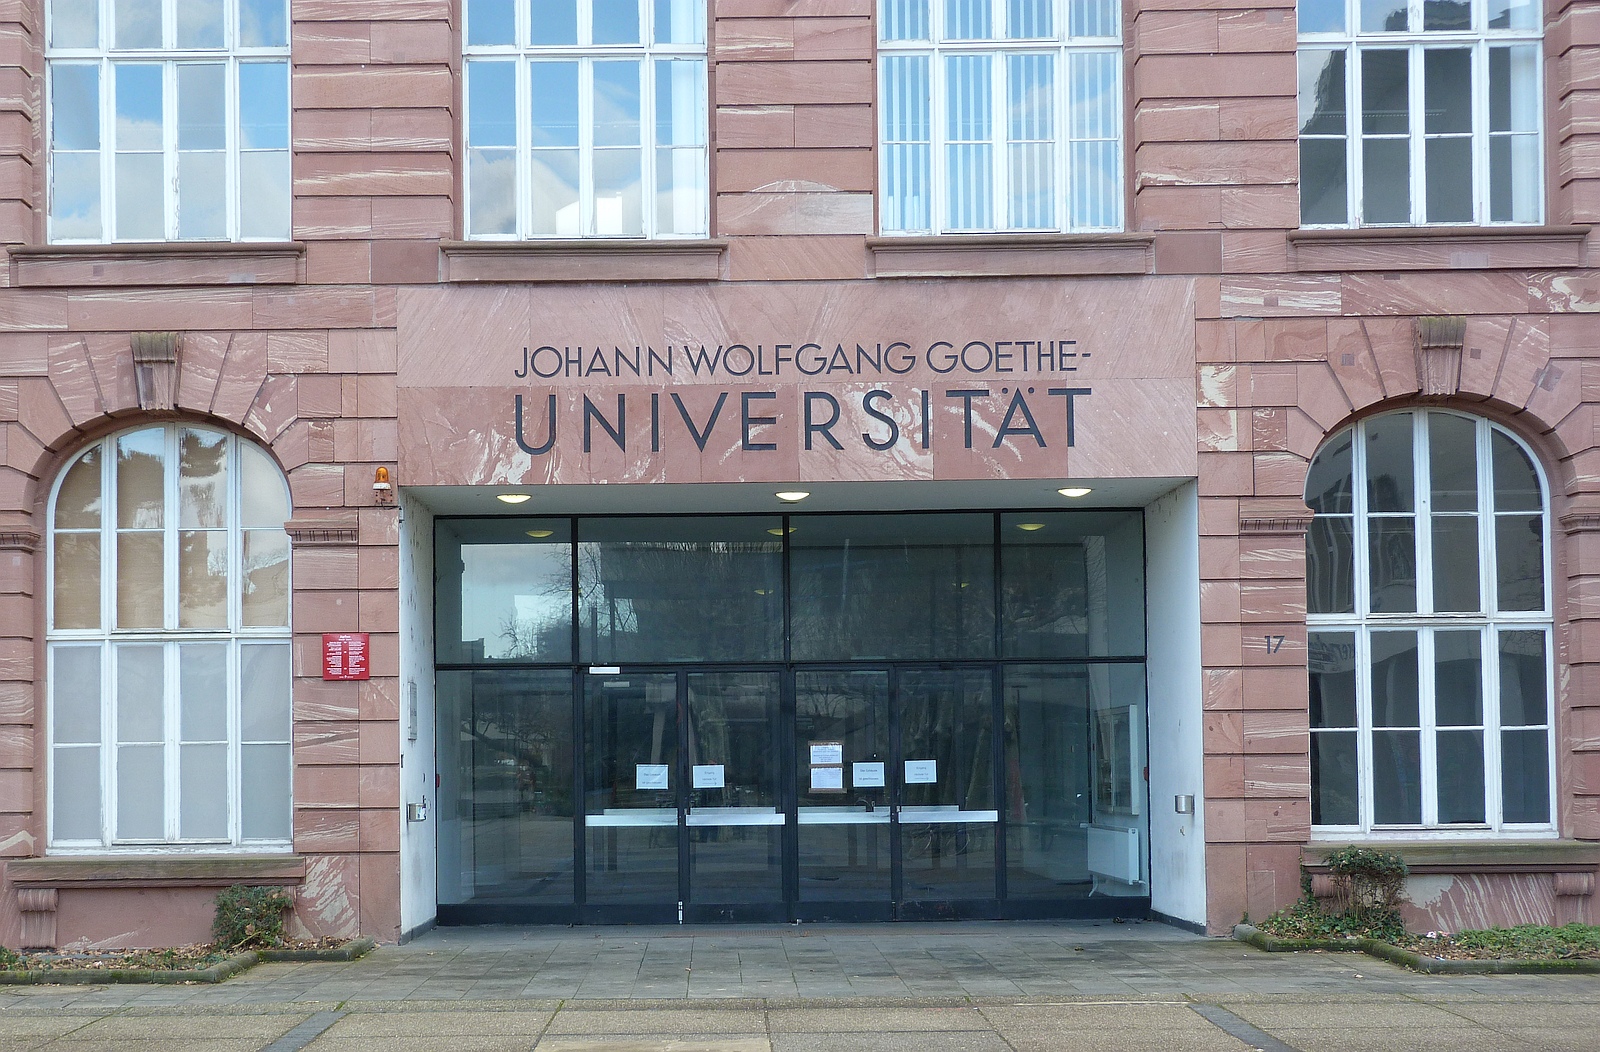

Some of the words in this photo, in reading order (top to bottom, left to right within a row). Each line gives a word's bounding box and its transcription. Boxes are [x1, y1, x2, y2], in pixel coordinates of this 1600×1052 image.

[514, 345, 673, 379] JOHANN
[684, 342, 916, 376] WOLFGANG
[926, 340, 1091, 374] GOETHE-
[514, 387, 1092, 455] UNIVERSITÄT
[1264, 635, 1286, 655] 17
